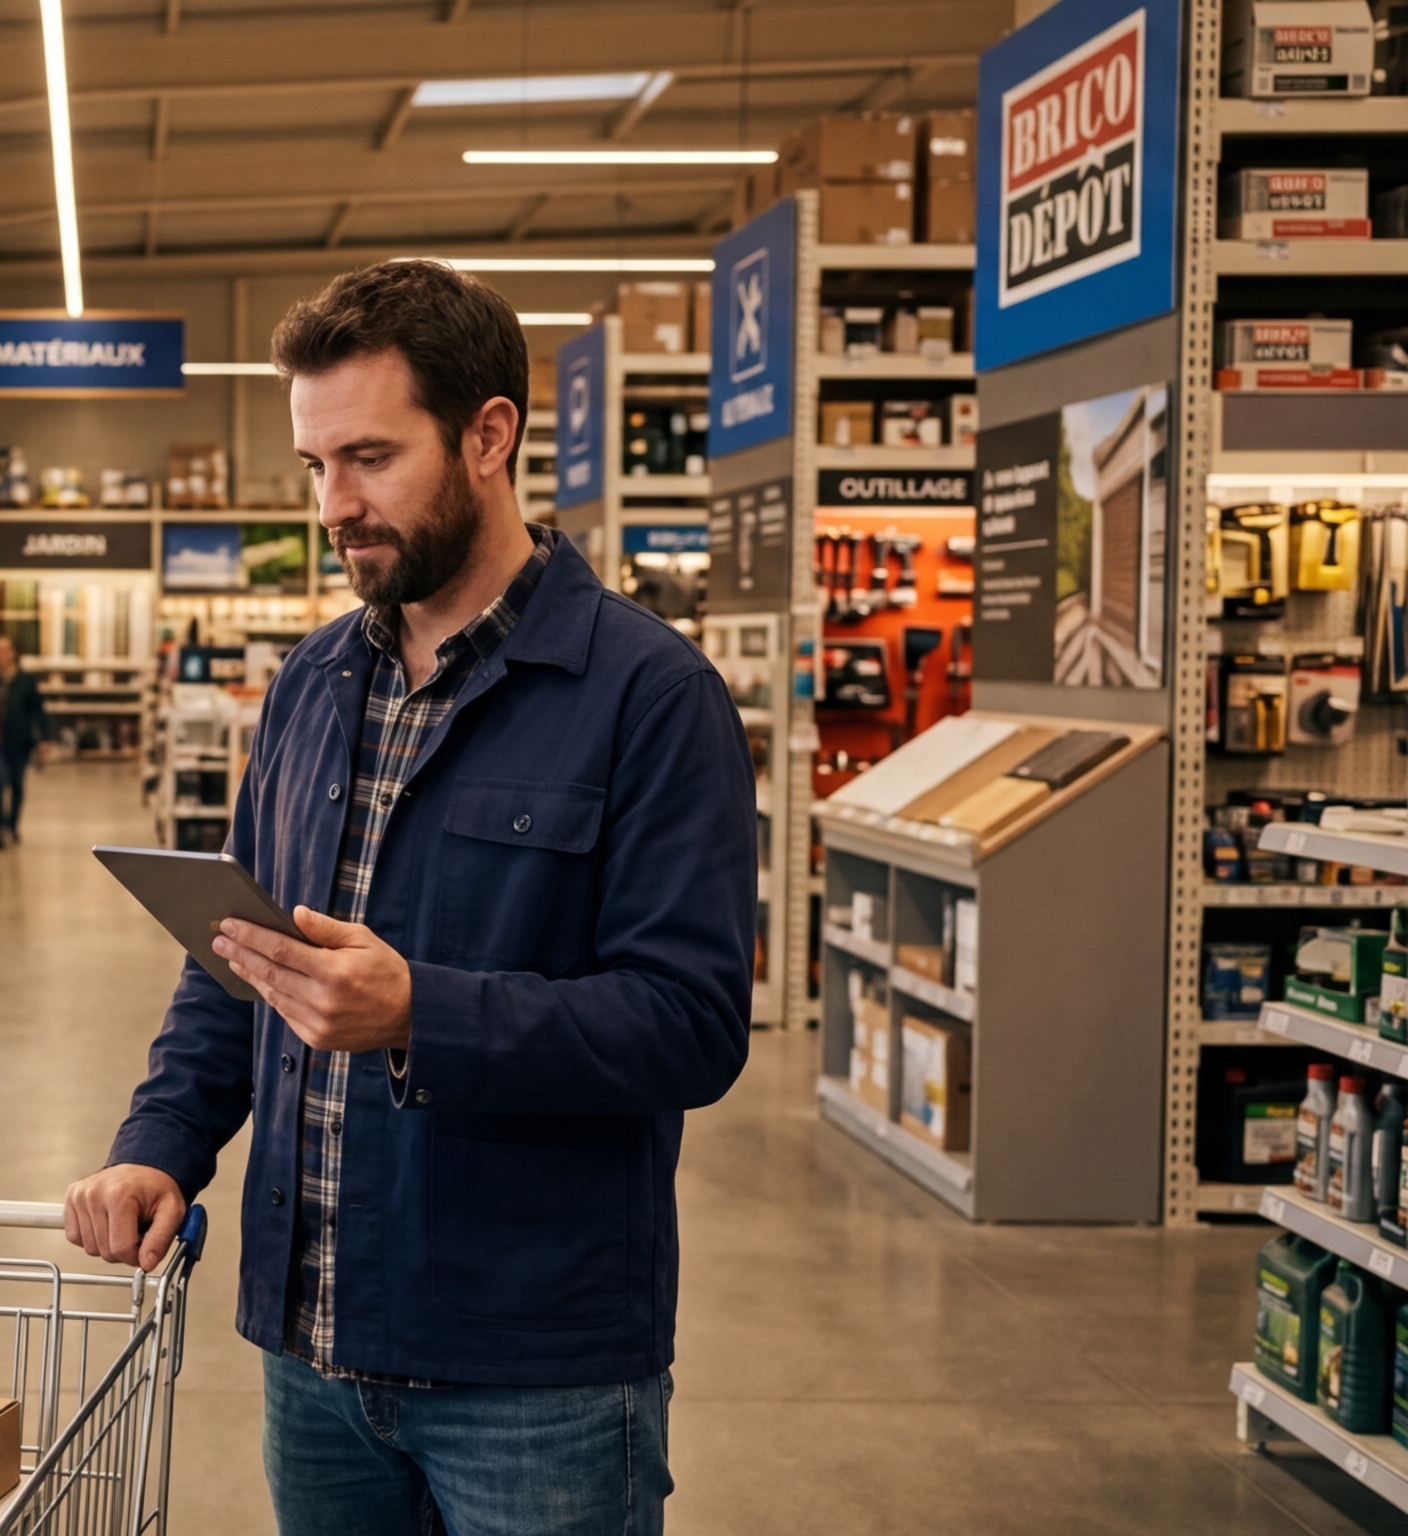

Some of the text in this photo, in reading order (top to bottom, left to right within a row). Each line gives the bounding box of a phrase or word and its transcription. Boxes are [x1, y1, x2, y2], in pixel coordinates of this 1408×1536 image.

[1011, 53, 1133, 178] BRICO
[1009, 144, 1131, 277] DÉPÔT
[839, 477, 967, 499] OUTILLAGE
